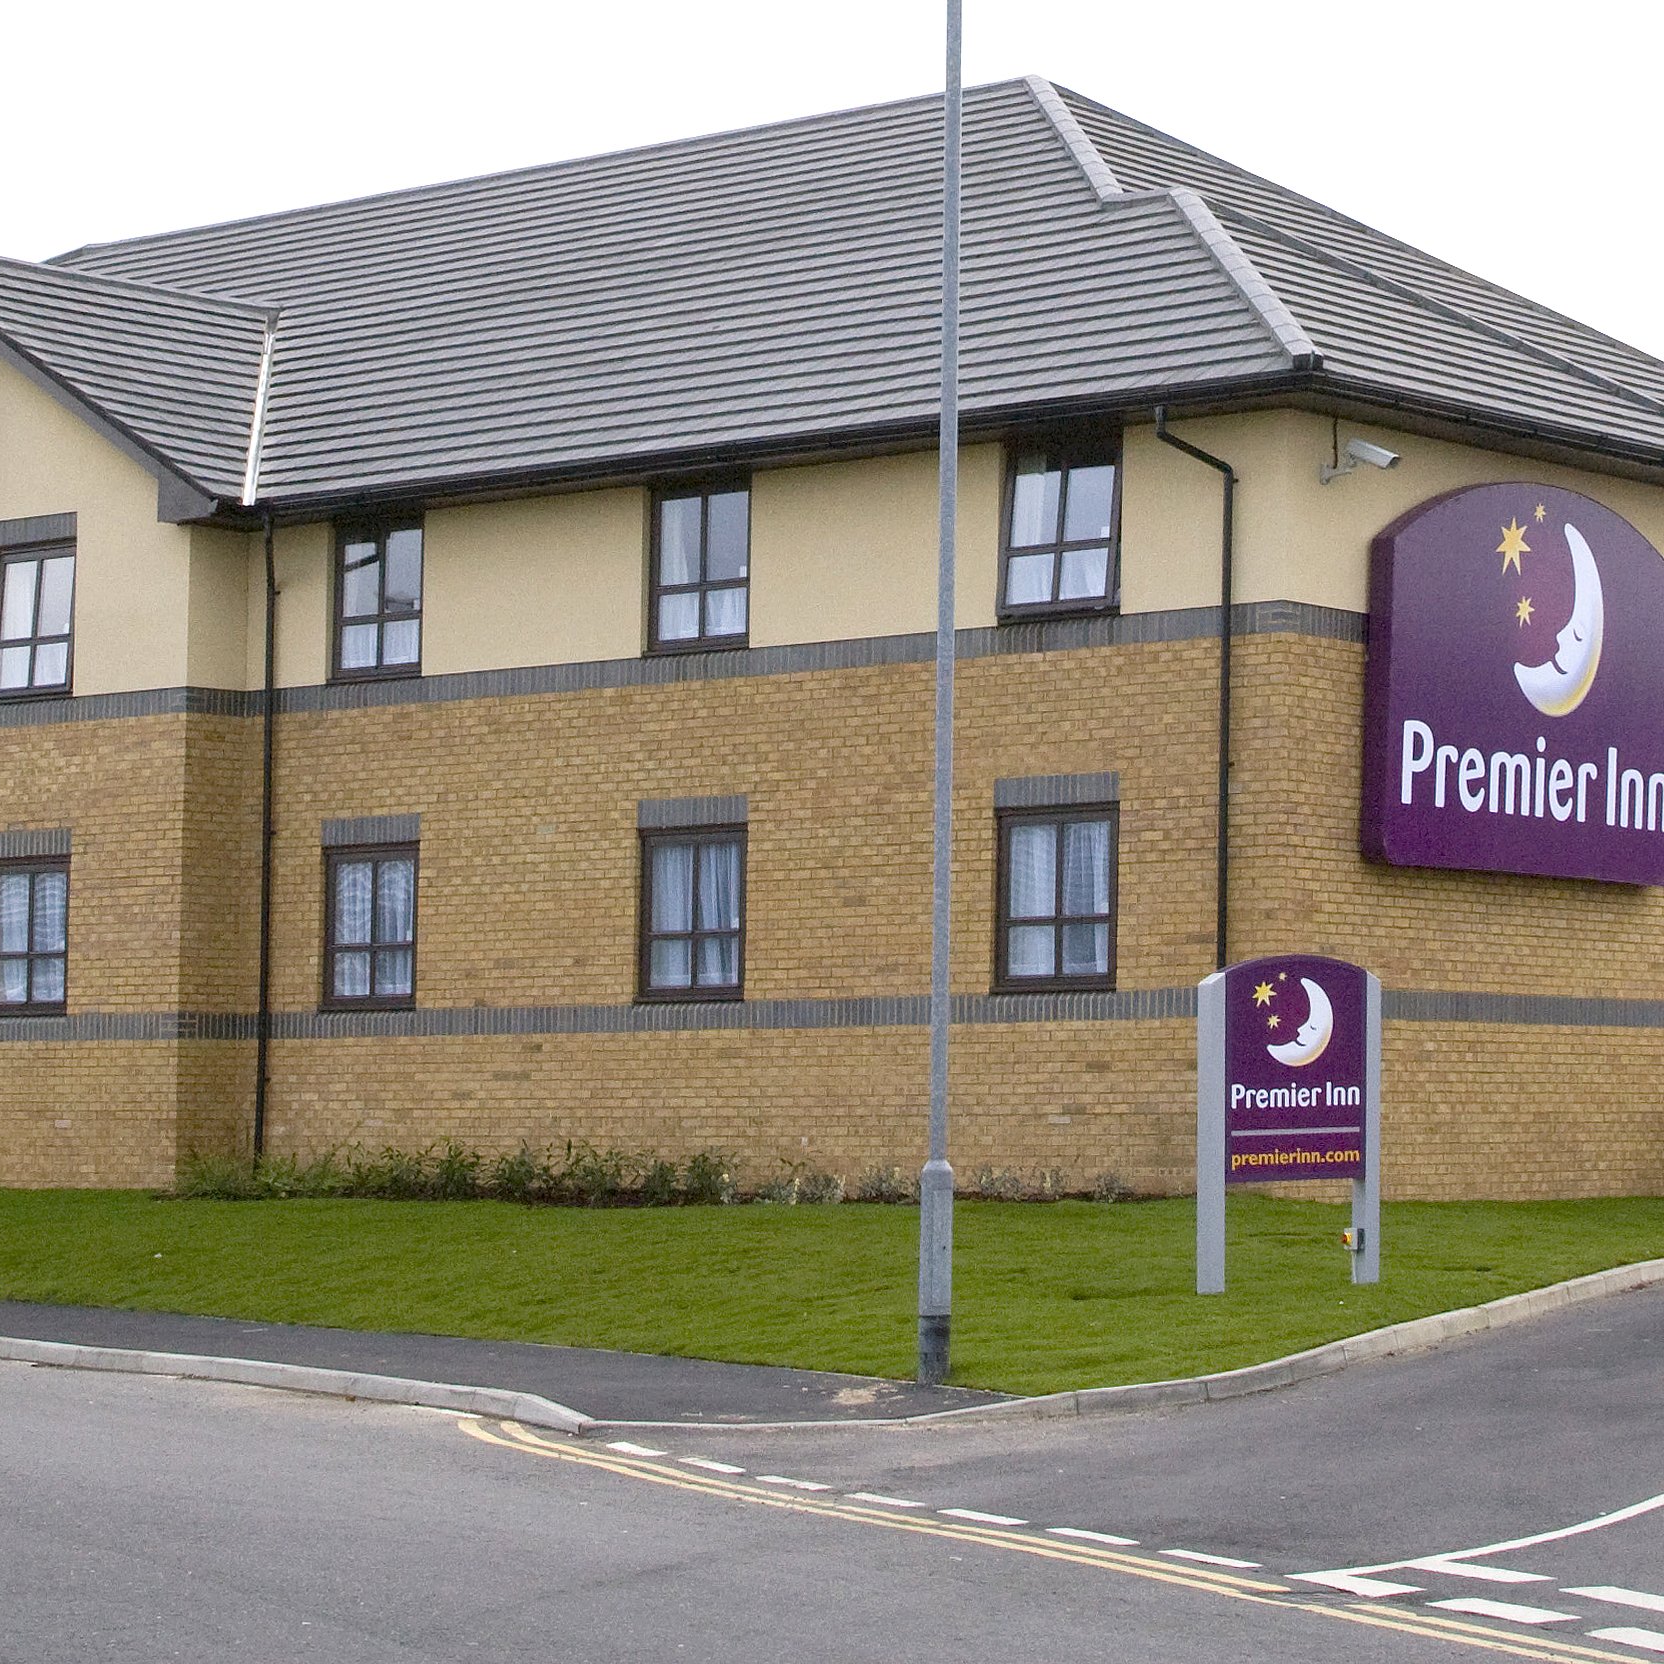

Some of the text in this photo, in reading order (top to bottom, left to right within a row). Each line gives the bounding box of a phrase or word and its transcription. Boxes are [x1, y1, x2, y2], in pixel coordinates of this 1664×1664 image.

[1401, 719, 1598, 822] Premier
[1231, 1081, 1361, 1109] Premier Inn
[1231, 1148, 1360, 1171] premierinn.com
